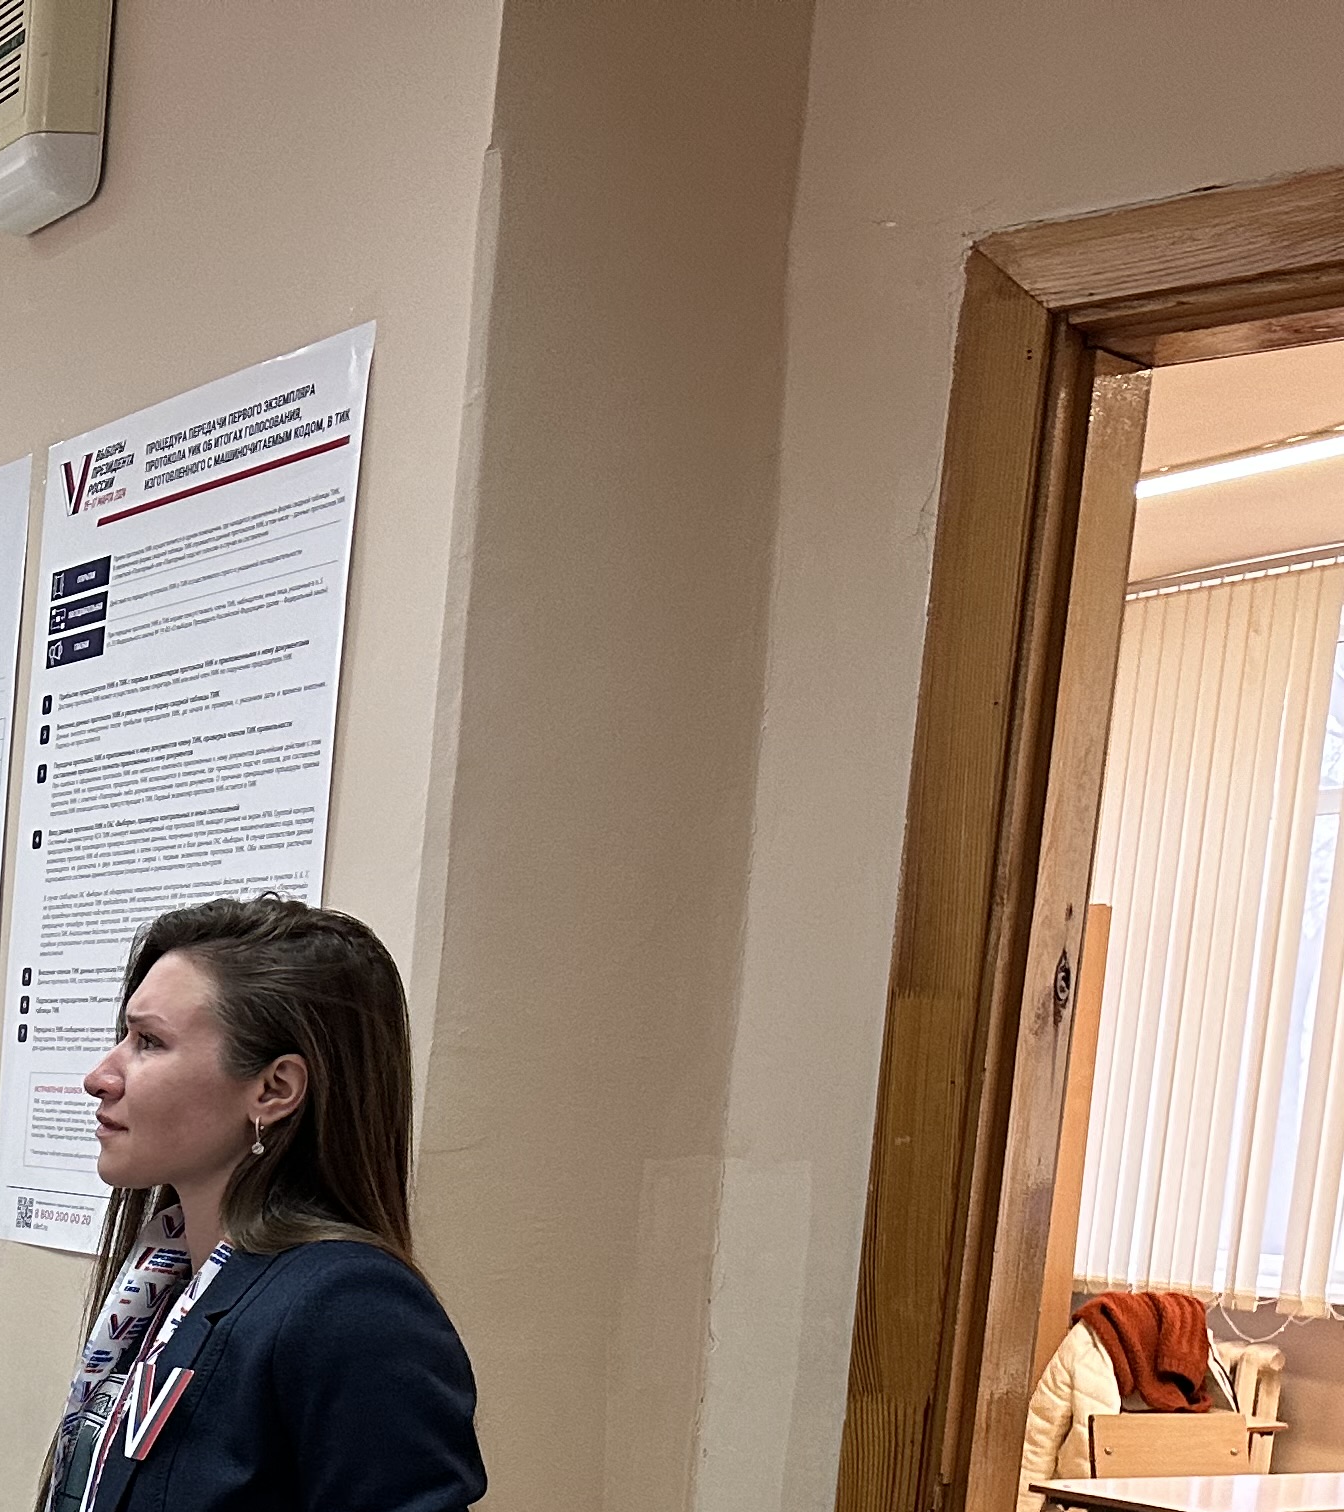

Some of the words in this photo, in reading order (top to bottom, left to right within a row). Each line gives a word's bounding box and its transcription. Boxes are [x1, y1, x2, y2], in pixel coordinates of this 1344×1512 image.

[146, 430, 187, 455] ПРОЦЕДУРА
[189, 415, 227, 439] ПЕРЕДАЧИ
[228, 403, 262, 425] ПЕРВОГО
[203, 439, 213, 453] ОБ
[214, 428, 243, 449] ИТОГАХ
[207, 457, 212, 469] С
[294, 418, 325, 439] КОДОМ,
[327, 415, 333, 428] В
